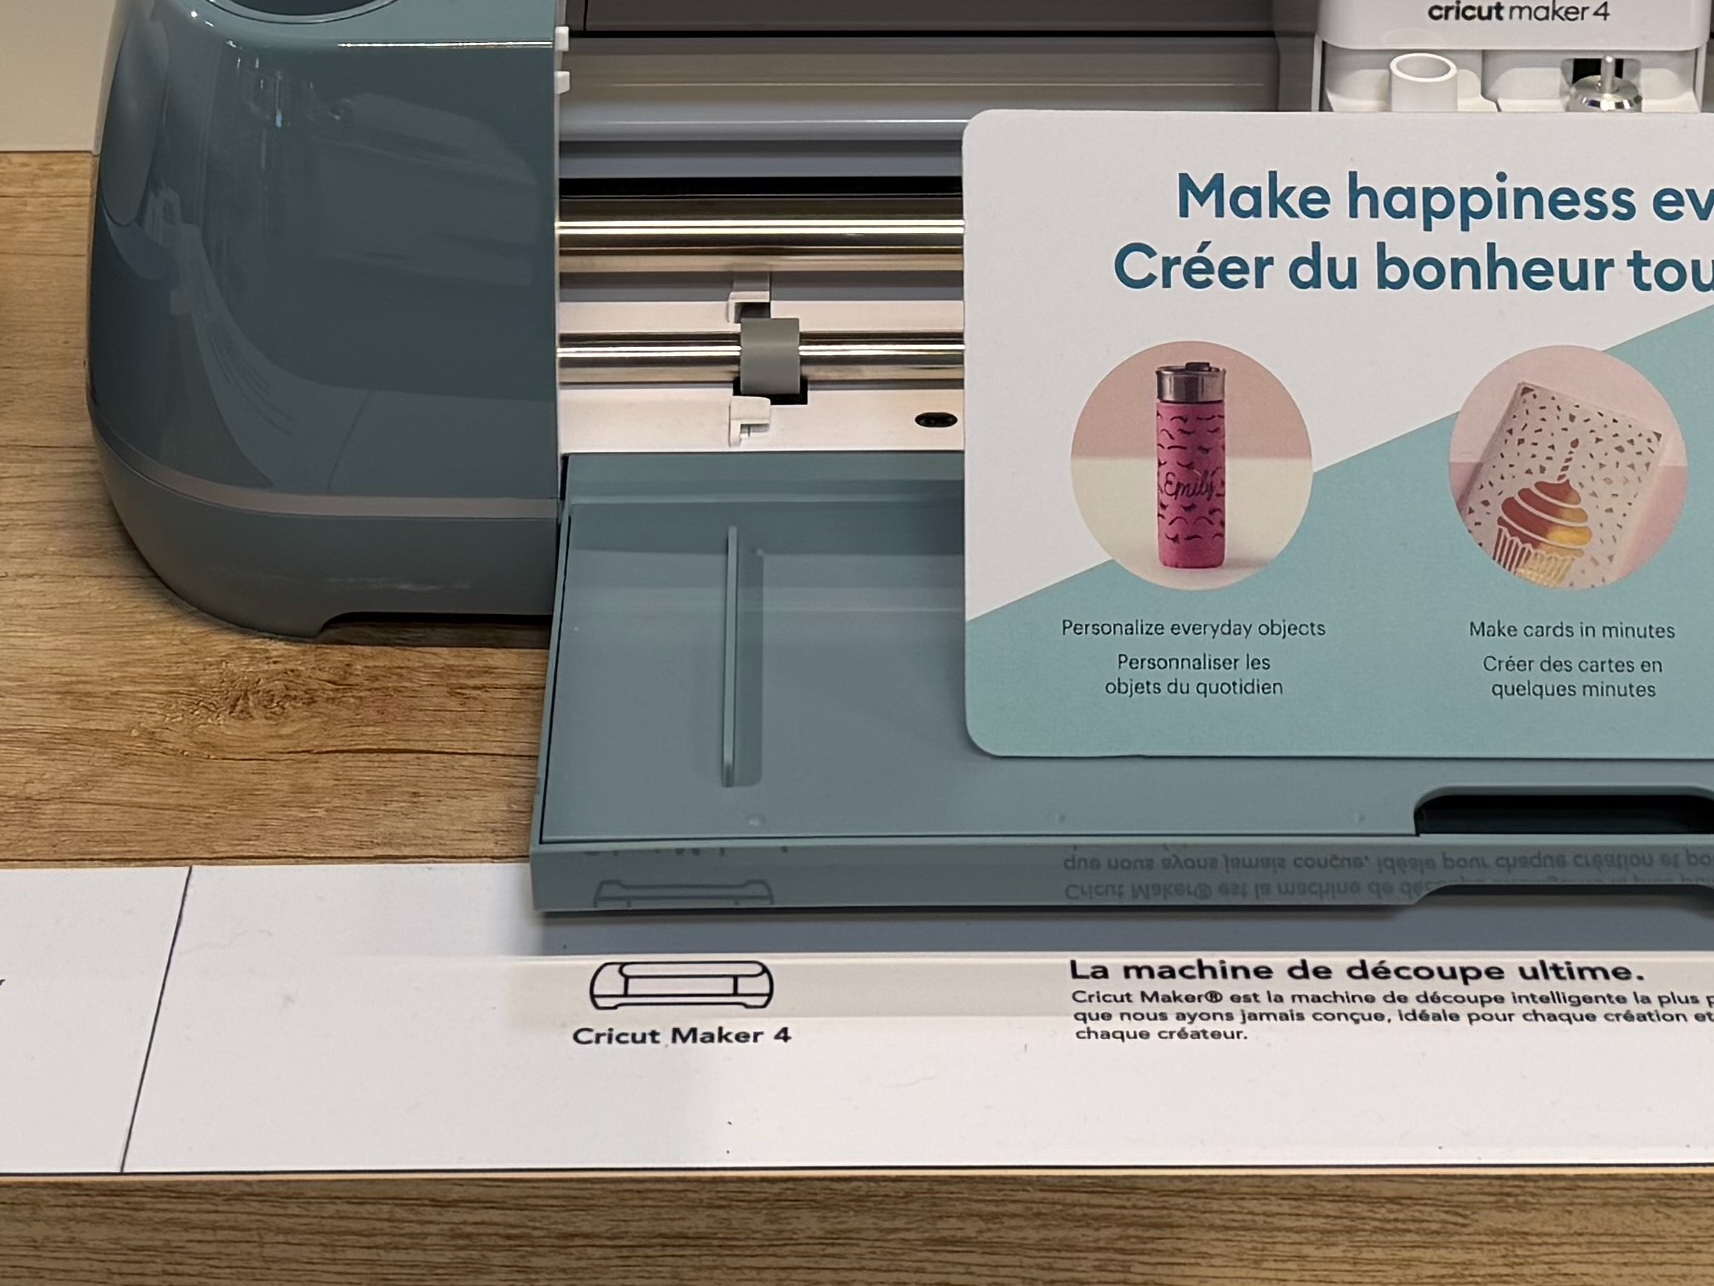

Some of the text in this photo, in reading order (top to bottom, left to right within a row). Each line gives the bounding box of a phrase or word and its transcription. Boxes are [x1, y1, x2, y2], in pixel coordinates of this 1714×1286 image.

[1427, 0, 1505, 22] cricut
[1592, 0, 1610, 21] 4
[1178, 170, 1331, 219] Make
[1348, 170, 1637, 233] happiness
[1114, 240, 1275, 290] Créer
[1288, 240, 1358, 290] du
[1376, 241, 1615, 292] bonheur
[1062, 618, 1326, 640] Personalize everyday objects
[1470, 619, 1676, 639] Make cards in minutes
[1118, 652, 1271, 671] Personnaliser les
[1483, 655, 1663, 673] Créer des cartes en
[1105, 676, 1283, 699] objets du quotidien
[1491, 679, 1656, 700] quelques minutes
[1070, 958, 1644, 986] La machine de découpe ultime.
[1071, 990, 1133, 1004] Cricut
[1140, 990, 1224, 1004] Maker®
[1229, 992, 1261, 1004] est
[1266, 990, 1284, 1004] la
[1290, 990, 1376, 1004] machine
[1382, 990, 1409, 1004] de
[1415, 990, 1506, 1008] découpe
[1510, 990, 1628, 1008] intelligente
[1632, 991, 1652, 1005] la
[1657, 991, 1700, 1008] plus
[572, 1025, 792, 1045] Cricut Maker 4
